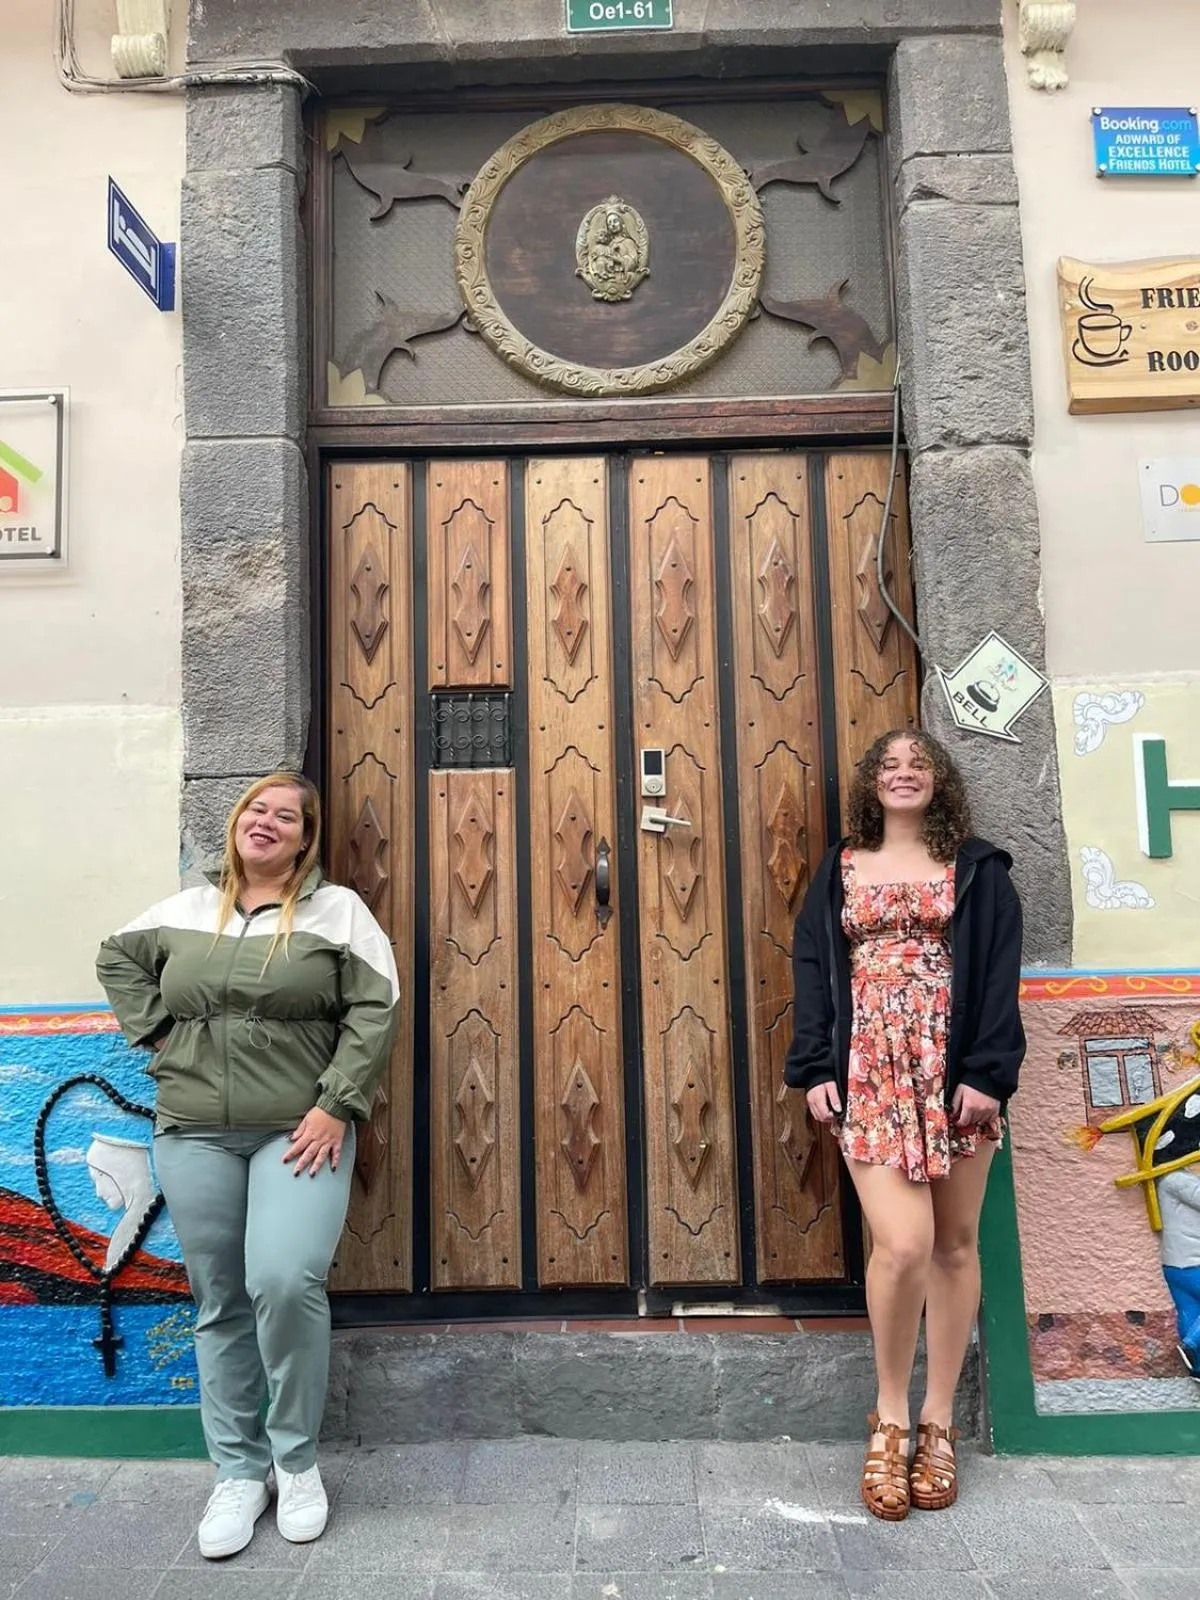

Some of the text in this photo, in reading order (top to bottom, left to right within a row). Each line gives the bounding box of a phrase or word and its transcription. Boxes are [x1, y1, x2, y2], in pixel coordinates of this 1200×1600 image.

[589, 1, 654, 20] Oe1-61
[1115, 134, 1181, 145] ADWARD OF
[1108, 146, 1190, 158] EXCELLENCE
[1109, 159, 1194, 171] FRIENDS HOTEL
[1140, 287, 1200, 309] FRIE
[1147, 350, 1200, 372] ROO
[0, 527, 42, 542] TEL
[952, 691, 987, 728] BELL
